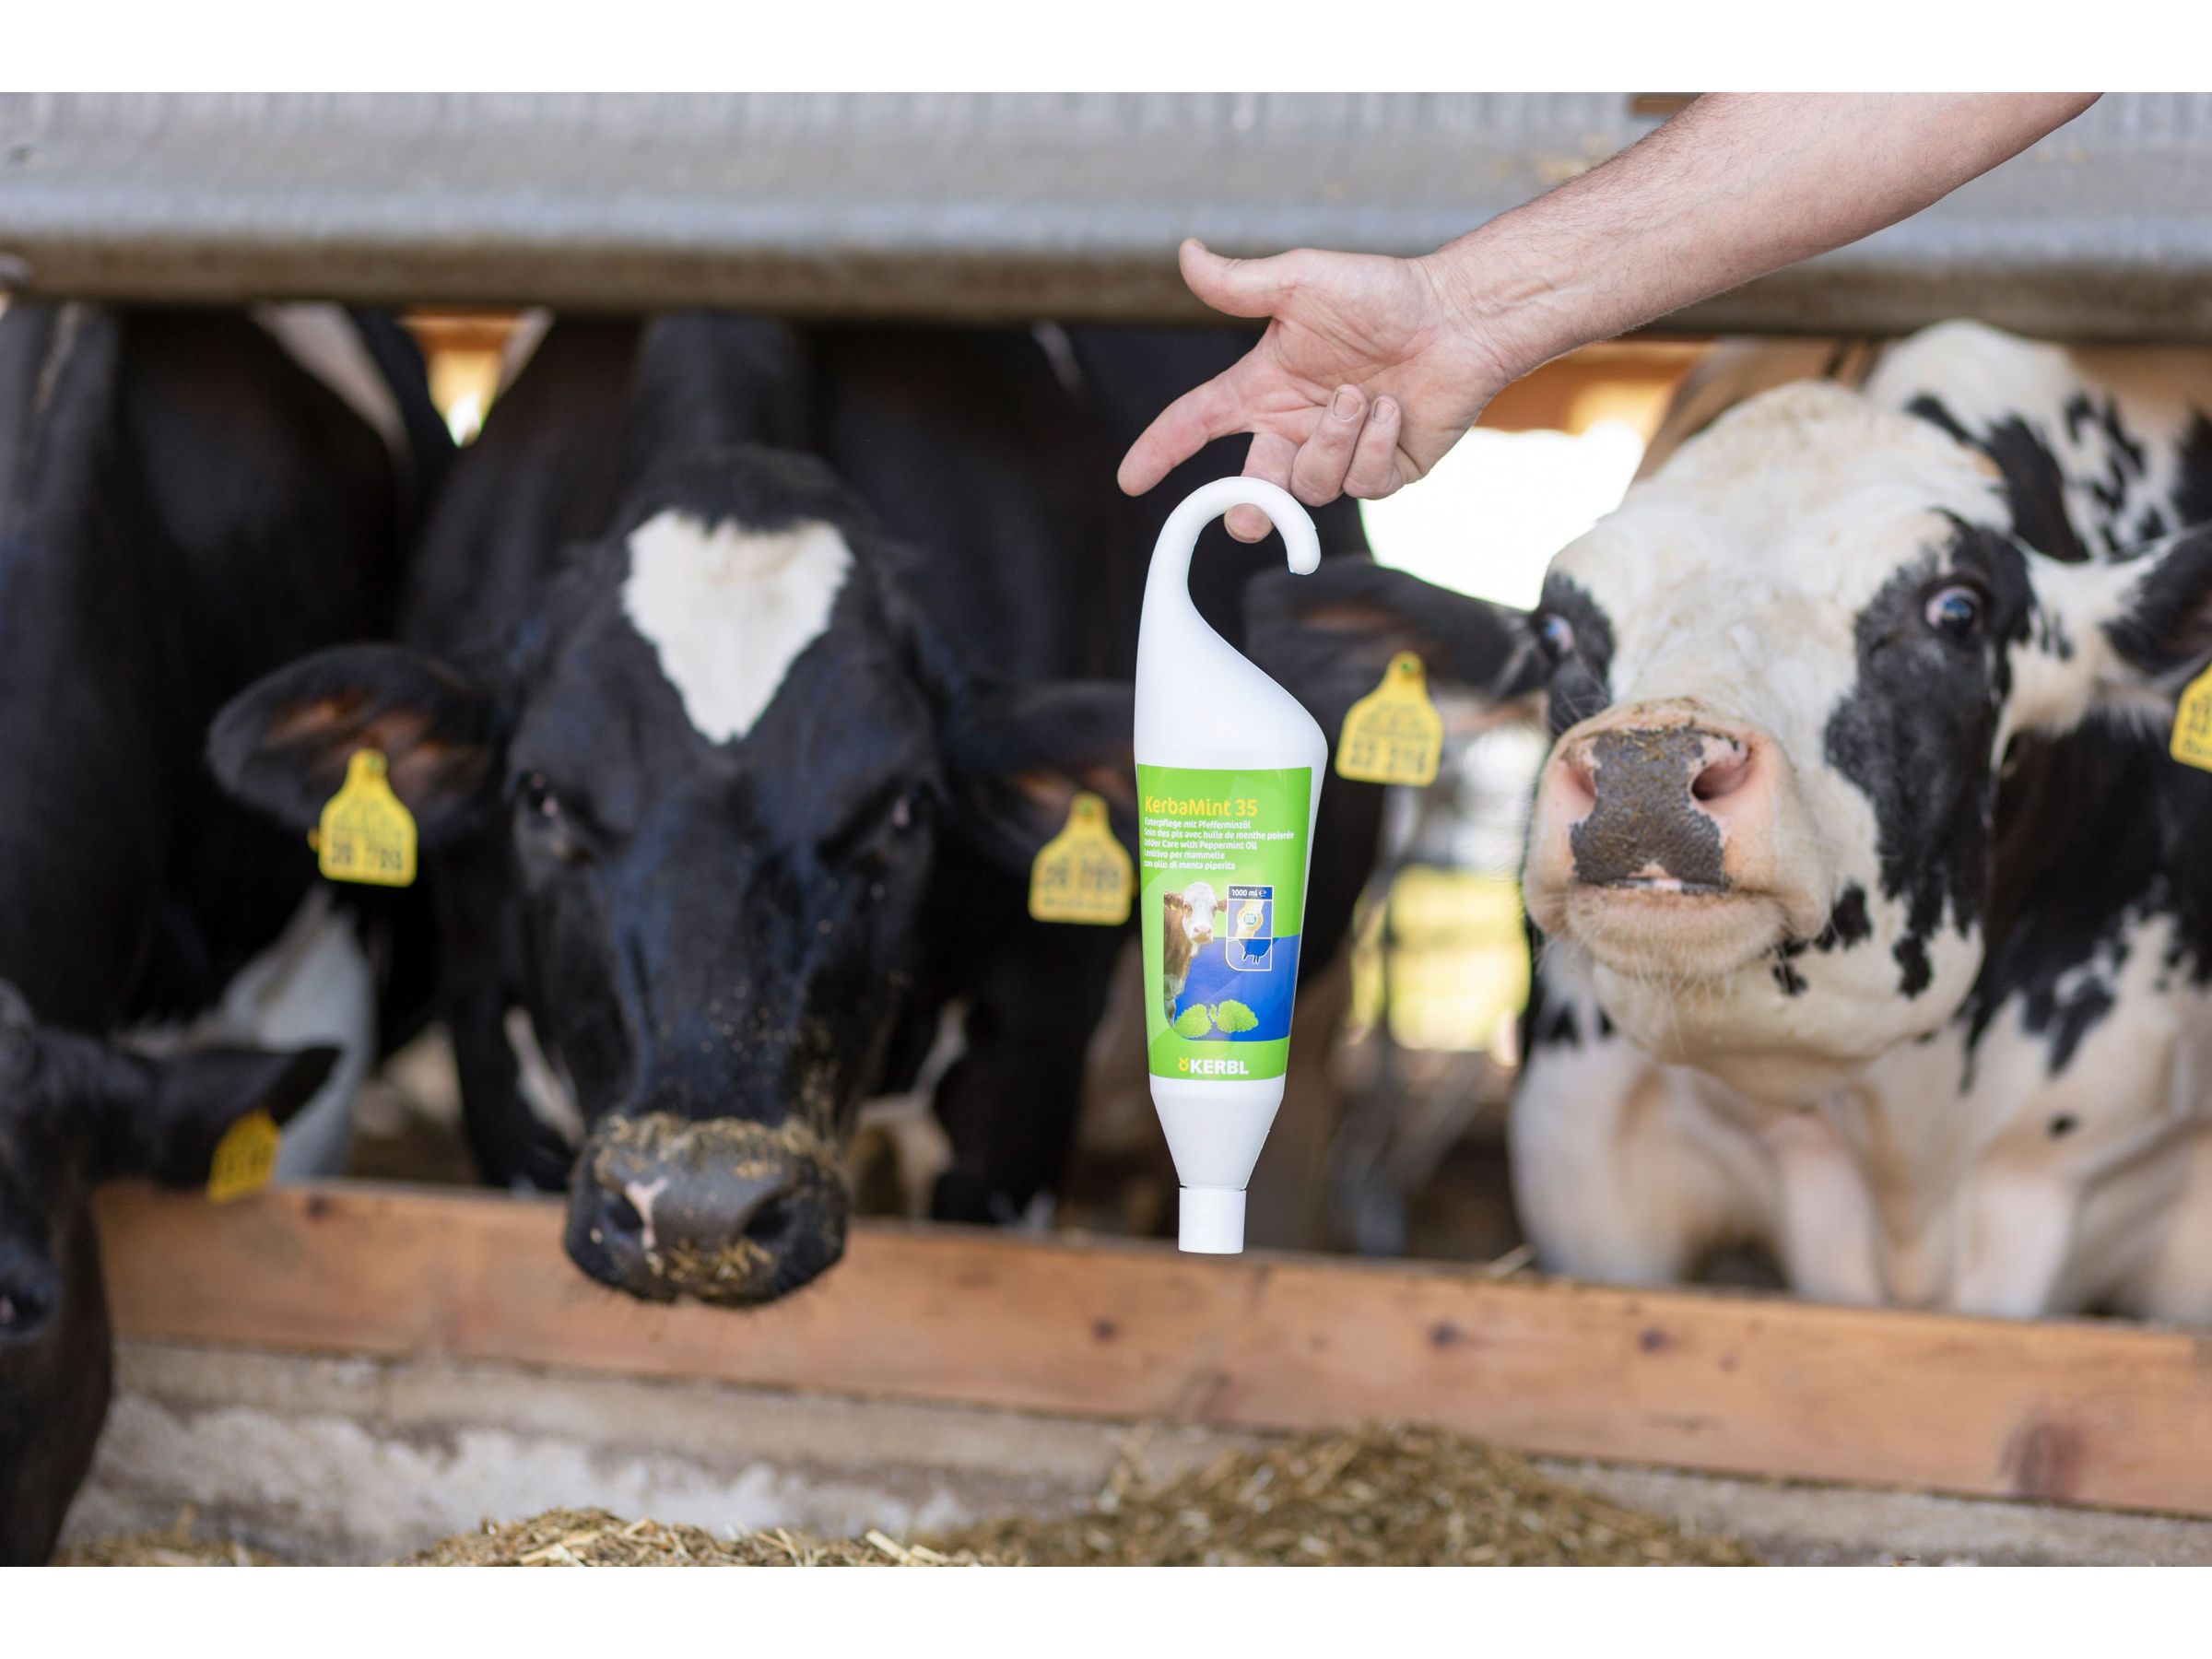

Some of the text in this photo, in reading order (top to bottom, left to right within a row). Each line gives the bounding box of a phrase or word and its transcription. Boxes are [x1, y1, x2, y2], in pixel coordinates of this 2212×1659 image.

[1145, 796, 1258, 817] KerbaMint 35
[1183, 820, 1197, 829] mit
[1198, 820, 1251, 830] Pfefferminzöl
[1157, 829, 1170, 838] des
[1171, 830, 1183, 840] pis
[1203, 830, 1223, 840] huile
[1225, 831, 1235, 840] de
[1236, 831, 1266, 840] menthe
[1162, 840, 1179, 848] Care
[1180, 840, 1197, 848] with
[1199, 841, 1243, 850] Peppermint
[1245, 841, 1257, 850] Oil
[1170, 851, 1182, 861] per
[1153, 859, 1168, 868] olio
[1170, 860, 1177, 869] di
[1179, 861, 1204, 869] menta
[1205, 861, 1235, 871] piperita
[1231, 888, 1247, 897] 1000
[1248, 888, 1258, 897] ml
[1190, 1059, 1249, 1075] KERBL
